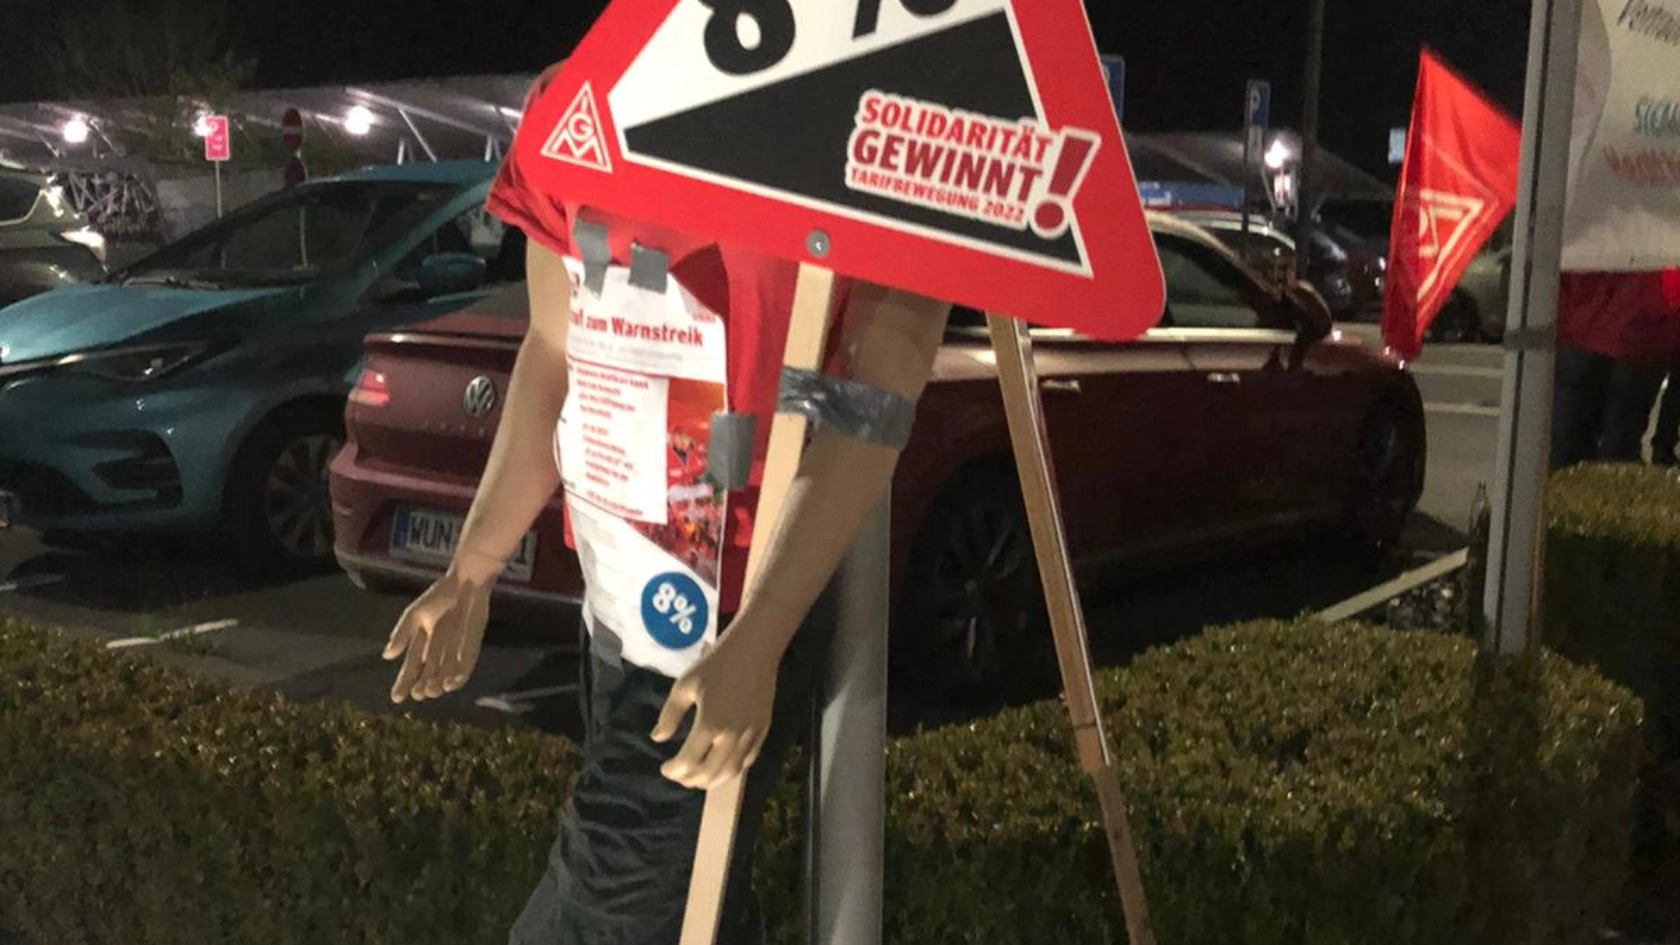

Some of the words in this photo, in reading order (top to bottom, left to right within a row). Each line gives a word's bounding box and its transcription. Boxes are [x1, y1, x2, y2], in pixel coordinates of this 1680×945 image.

[862, 97, 1051, 163] SOLIDARITÄT
[850, 167, 979, 212] TARIFBEWEGUNG
[982, 201, 1025, 223] 2022
[611, 316, 703, 347] Warnstreik
[651, 581, 698, 636] 8%
